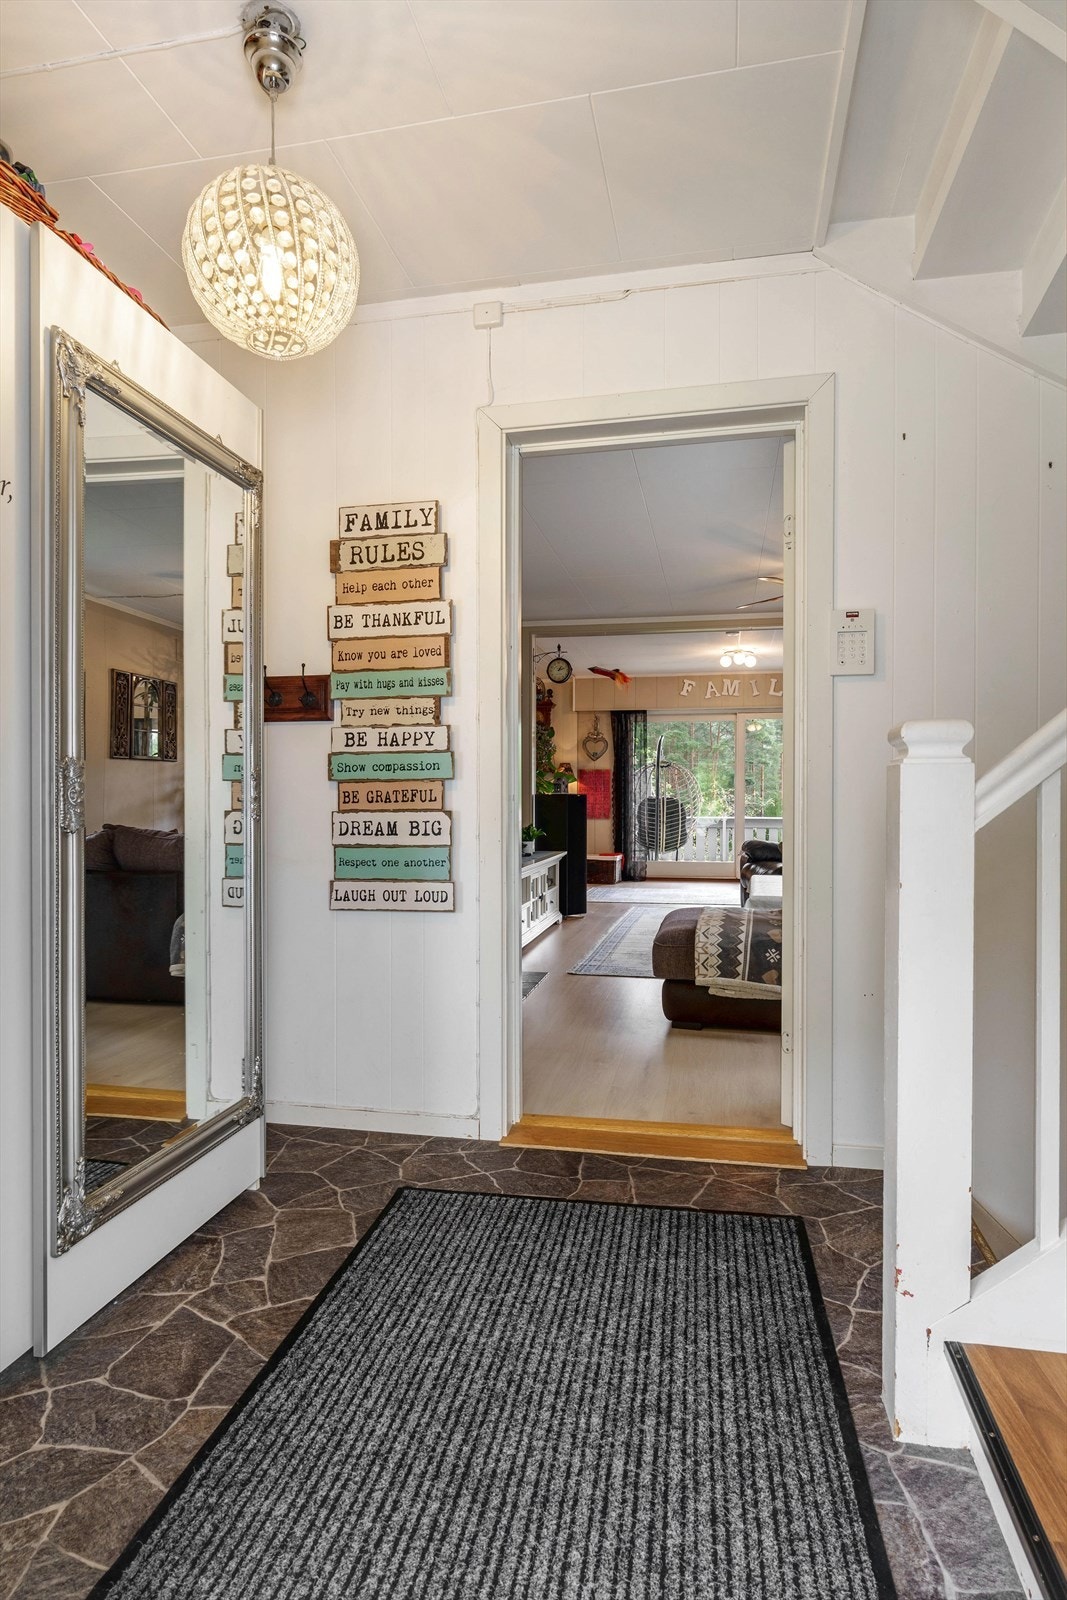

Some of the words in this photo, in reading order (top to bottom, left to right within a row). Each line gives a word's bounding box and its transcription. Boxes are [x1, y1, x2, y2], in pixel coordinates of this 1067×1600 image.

[344, 508, 433, 532] FAMILY
[350, 542, 425, 565] RULES
[342, 583, 367, 594] Help
[372, 580, 396, 591] each
[402, 579, 434, 590] other
[334, 615, 353, 629] BE
[362, 611, 445, 628] THANKFUL
[338, 651, 363, 662] Know
[368, 650, 386, 662] you
[390, 648, 408, 659] are
[413, 646, 442, 658] loved
[336, 680, 350, 692] Pay
[354, 679, 373, 689] with
[377, 679, 396, 689] hugs
[399, 677, 414, 688] and
[418, 677, 444, 687] kisses
[346, 706, 364, 718] Try
[370, 706, 390, 715] new
[396, 704, 434, 716] things
[345, 732, 367, 747] BE
[378, 731, 435, 746] HAPPY
[337, 762, 366, 773] Show
[372, 761, 440, 773] compassion
[342, 791, 359, 804] BE
[366, 789, 437, 803] GRATEFUL
[339, 821, 398, 836] DREAM
[409, 821, 442, 836] BIG
[339, 858, 376, 868] Respect
[404, 858, 446, 867] another
[334, 890, 375, 902] LAUGH
[382, 890, 407, 901] OUT
[415, 890, 448, 902] LOUD
